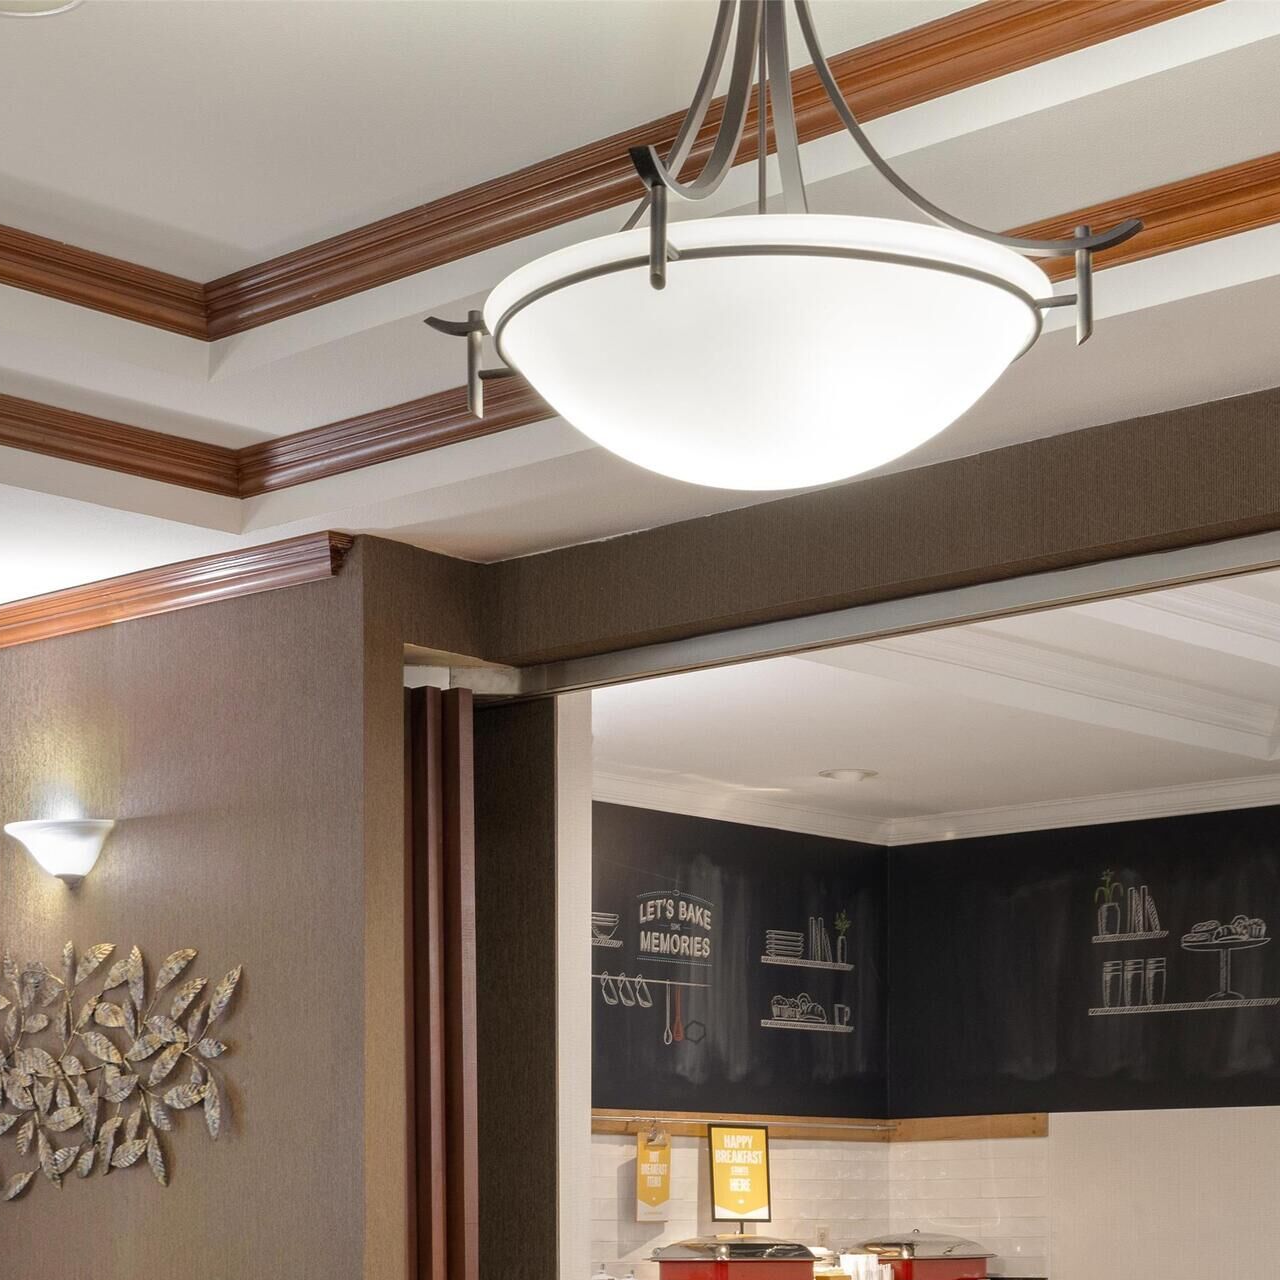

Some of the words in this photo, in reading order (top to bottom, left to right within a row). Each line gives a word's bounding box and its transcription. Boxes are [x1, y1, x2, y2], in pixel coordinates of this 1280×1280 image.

[639, 899, 675, 923] LET'S
[678, 901, 712, 930] BAKE
[639, 931, 711, 958] MEMORIES
[723, 1134, 754, 1149] HAPPY
[715, 1149, 764, 1165] BREAKFAST
